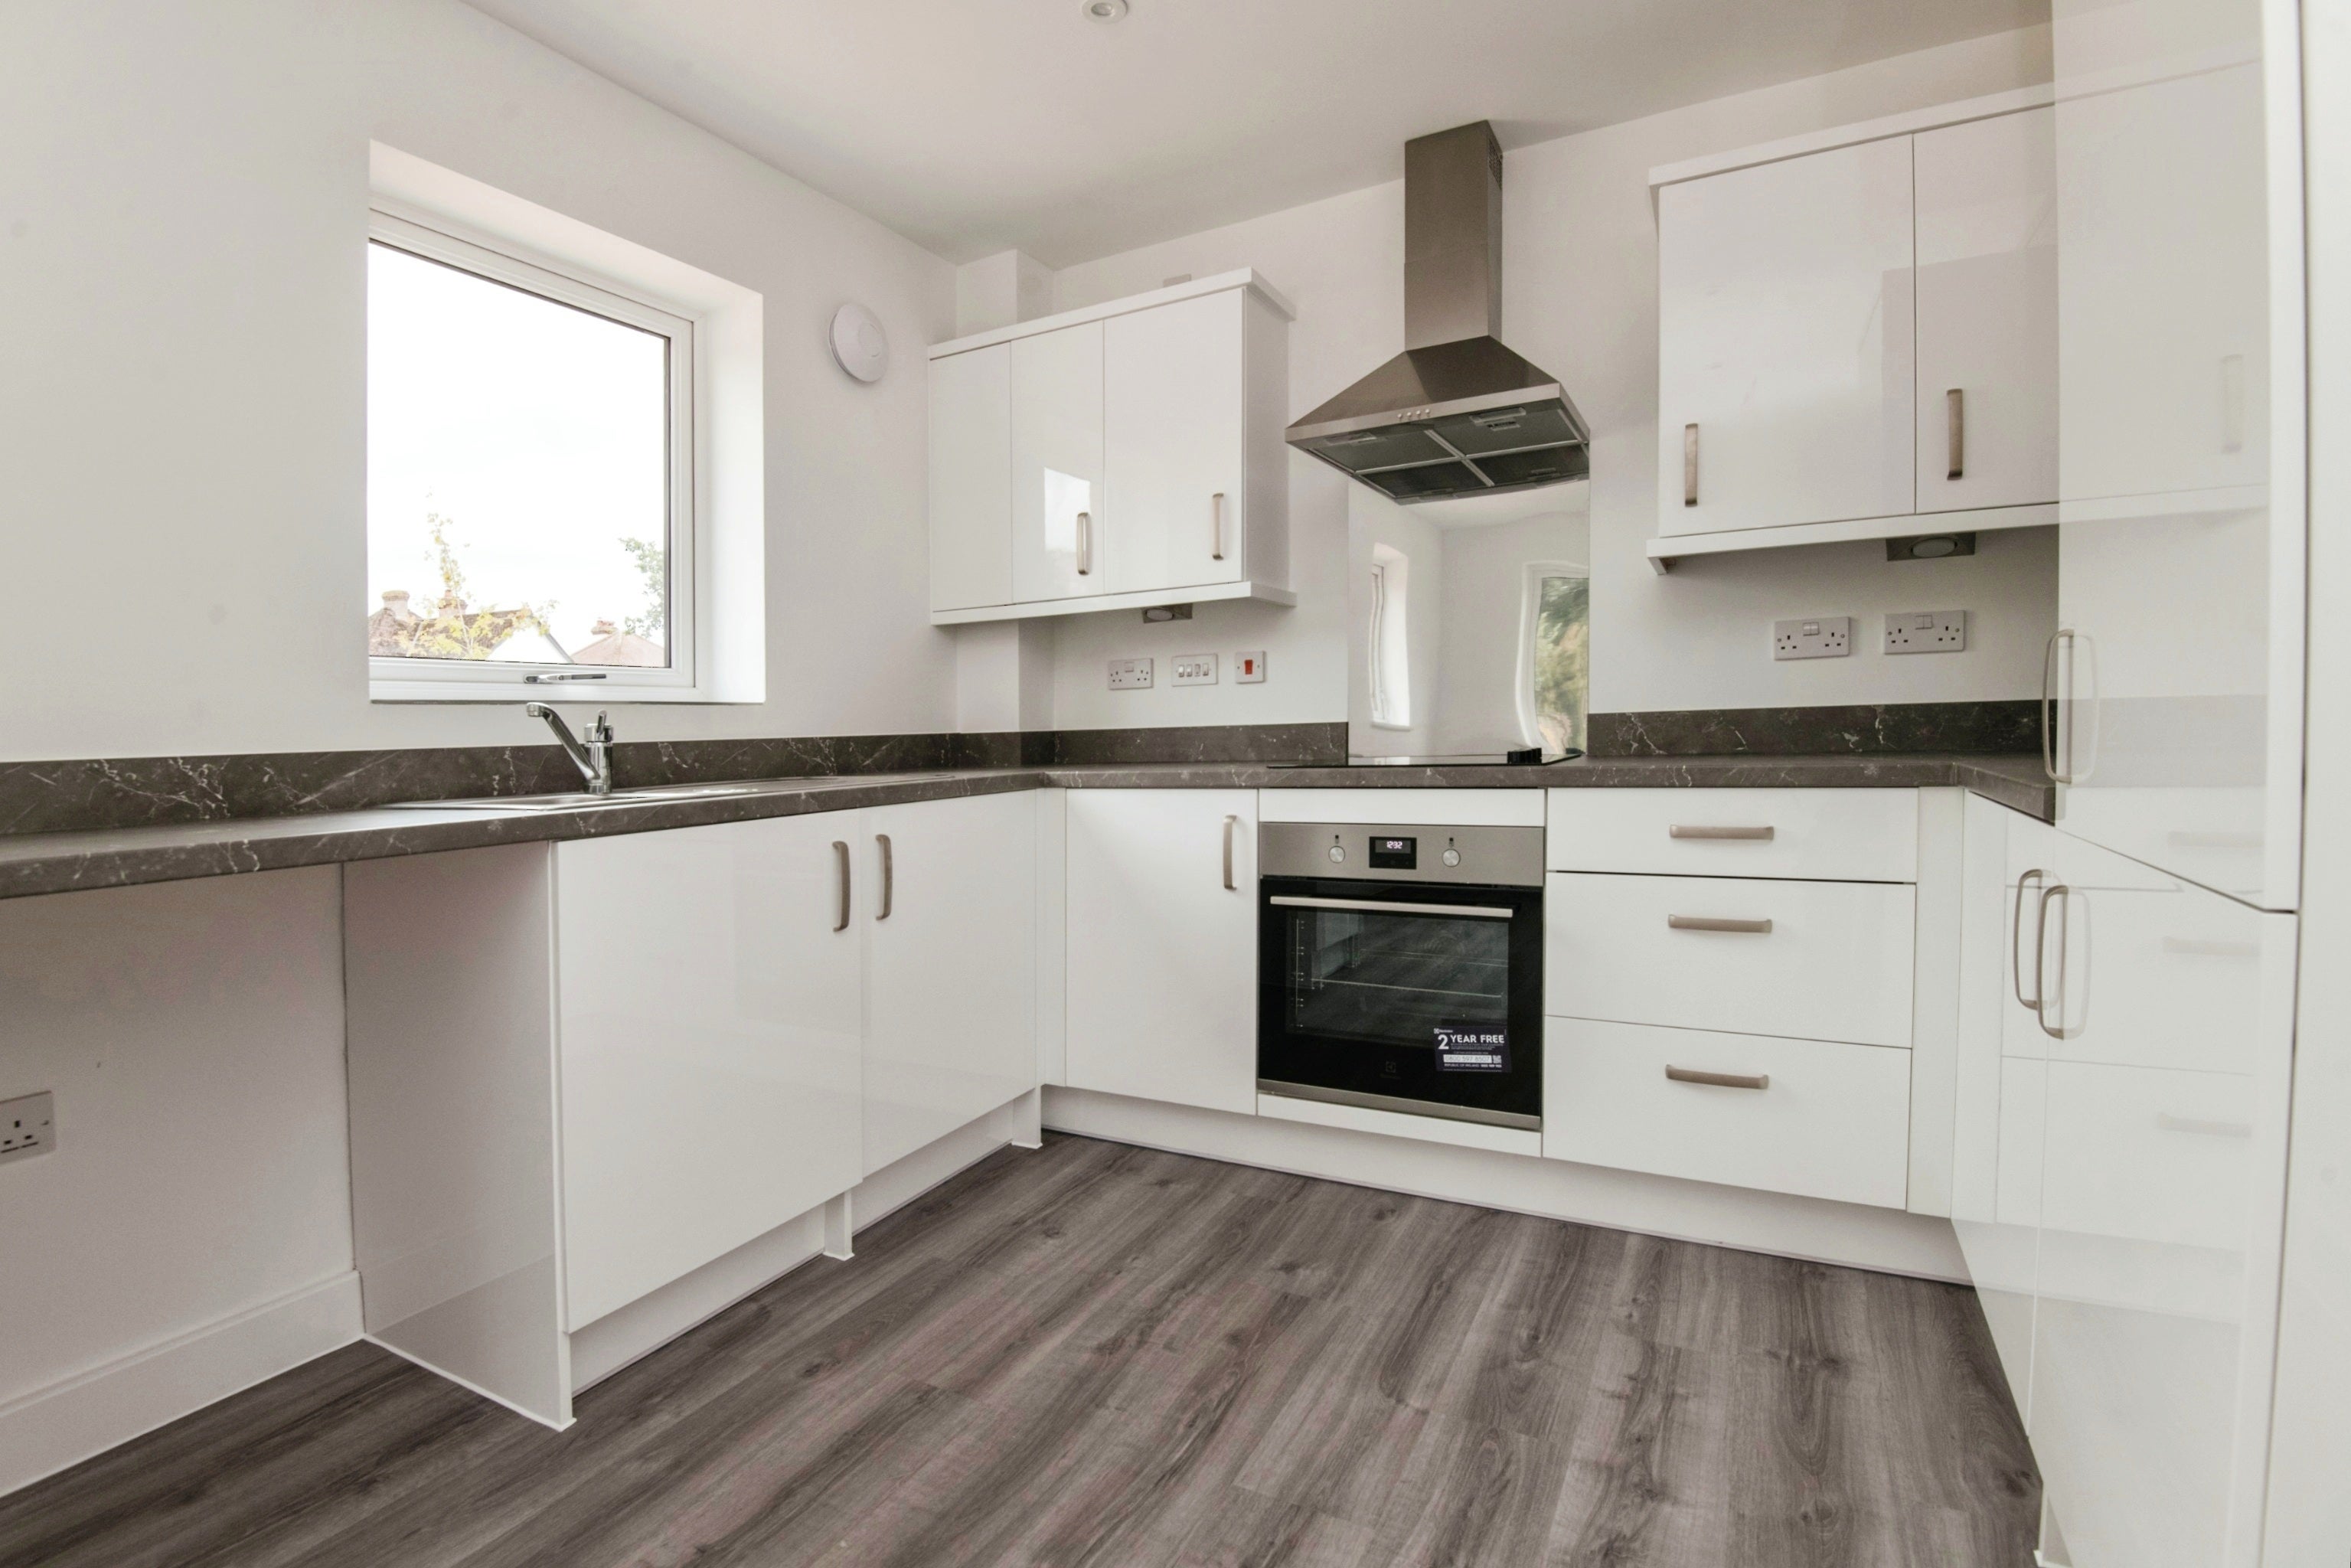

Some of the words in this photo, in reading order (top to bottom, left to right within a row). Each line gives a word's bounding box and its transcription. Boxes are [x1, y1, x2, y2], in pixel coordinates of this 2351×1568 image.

[1438, 1034, 1449, 1050] 2
[1450, 1034, 1477, 1043] YEAR
[1480, 1034, 1505, 1044] FREE
